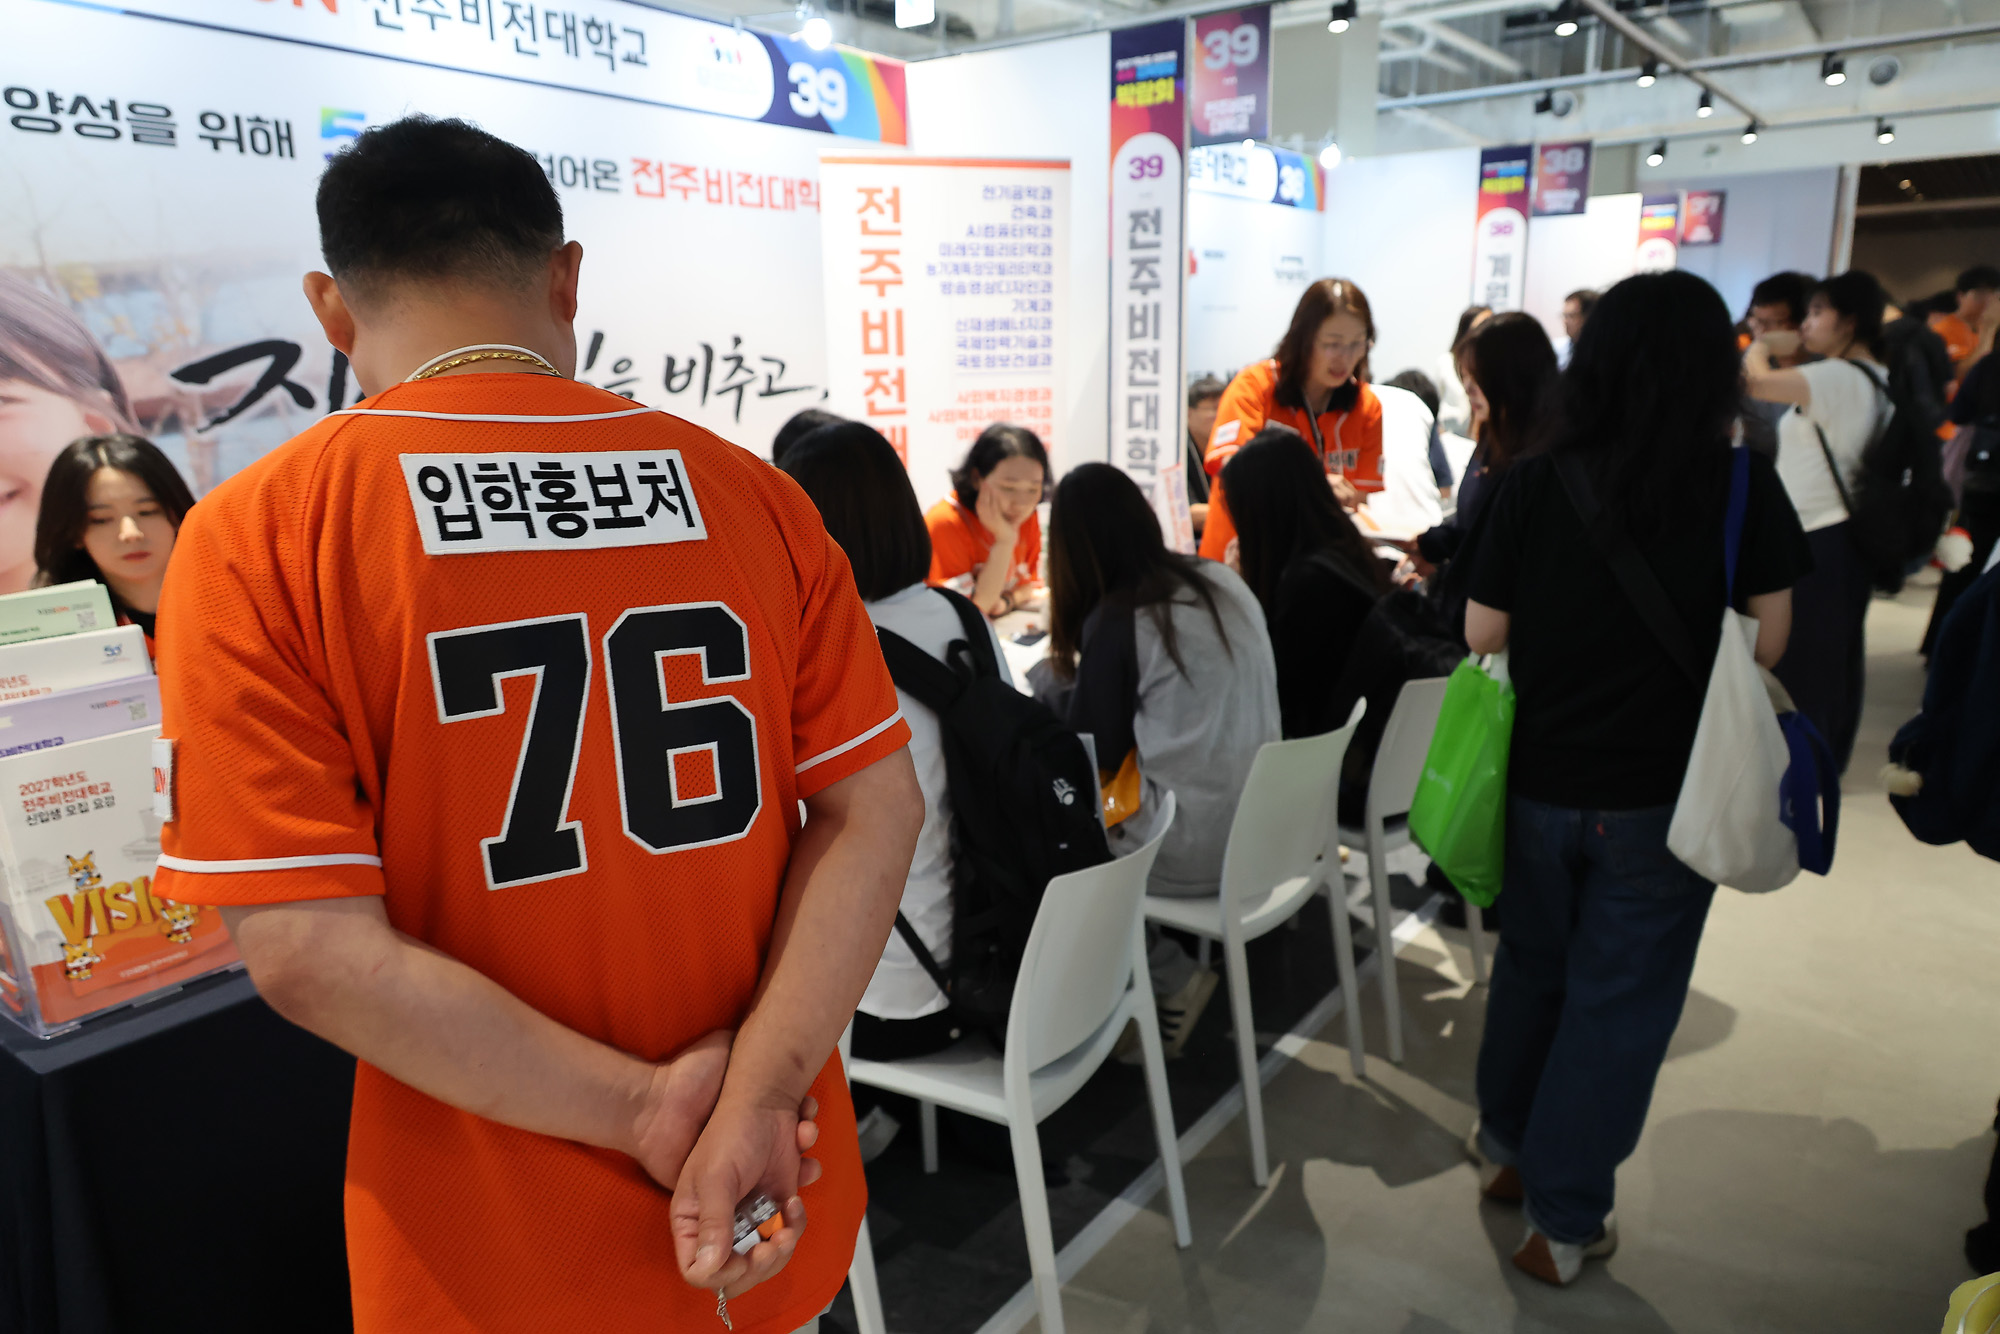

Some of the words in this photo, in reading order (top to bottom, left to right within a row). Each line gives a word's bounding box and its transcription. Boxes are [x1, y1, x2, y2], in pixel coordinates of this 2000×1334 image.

[1203, 24, 1261, 70] 39
[3, 86, 178, 148] 양성을
[198, 111, 296, 159] 위해
[787, 61, 849, 121] 39
[1129, 155, 1165, 181] 39
[170, 338, 366, 433] 지
[417, 458, 695, 541] 입학홍보처
[426, 601, 763, 891] 76
[19, 771, 88, 796] 2027학년도
[22, 782, 113, 812] 전주비전대학교
[44, 876, 217, 946] VISI
